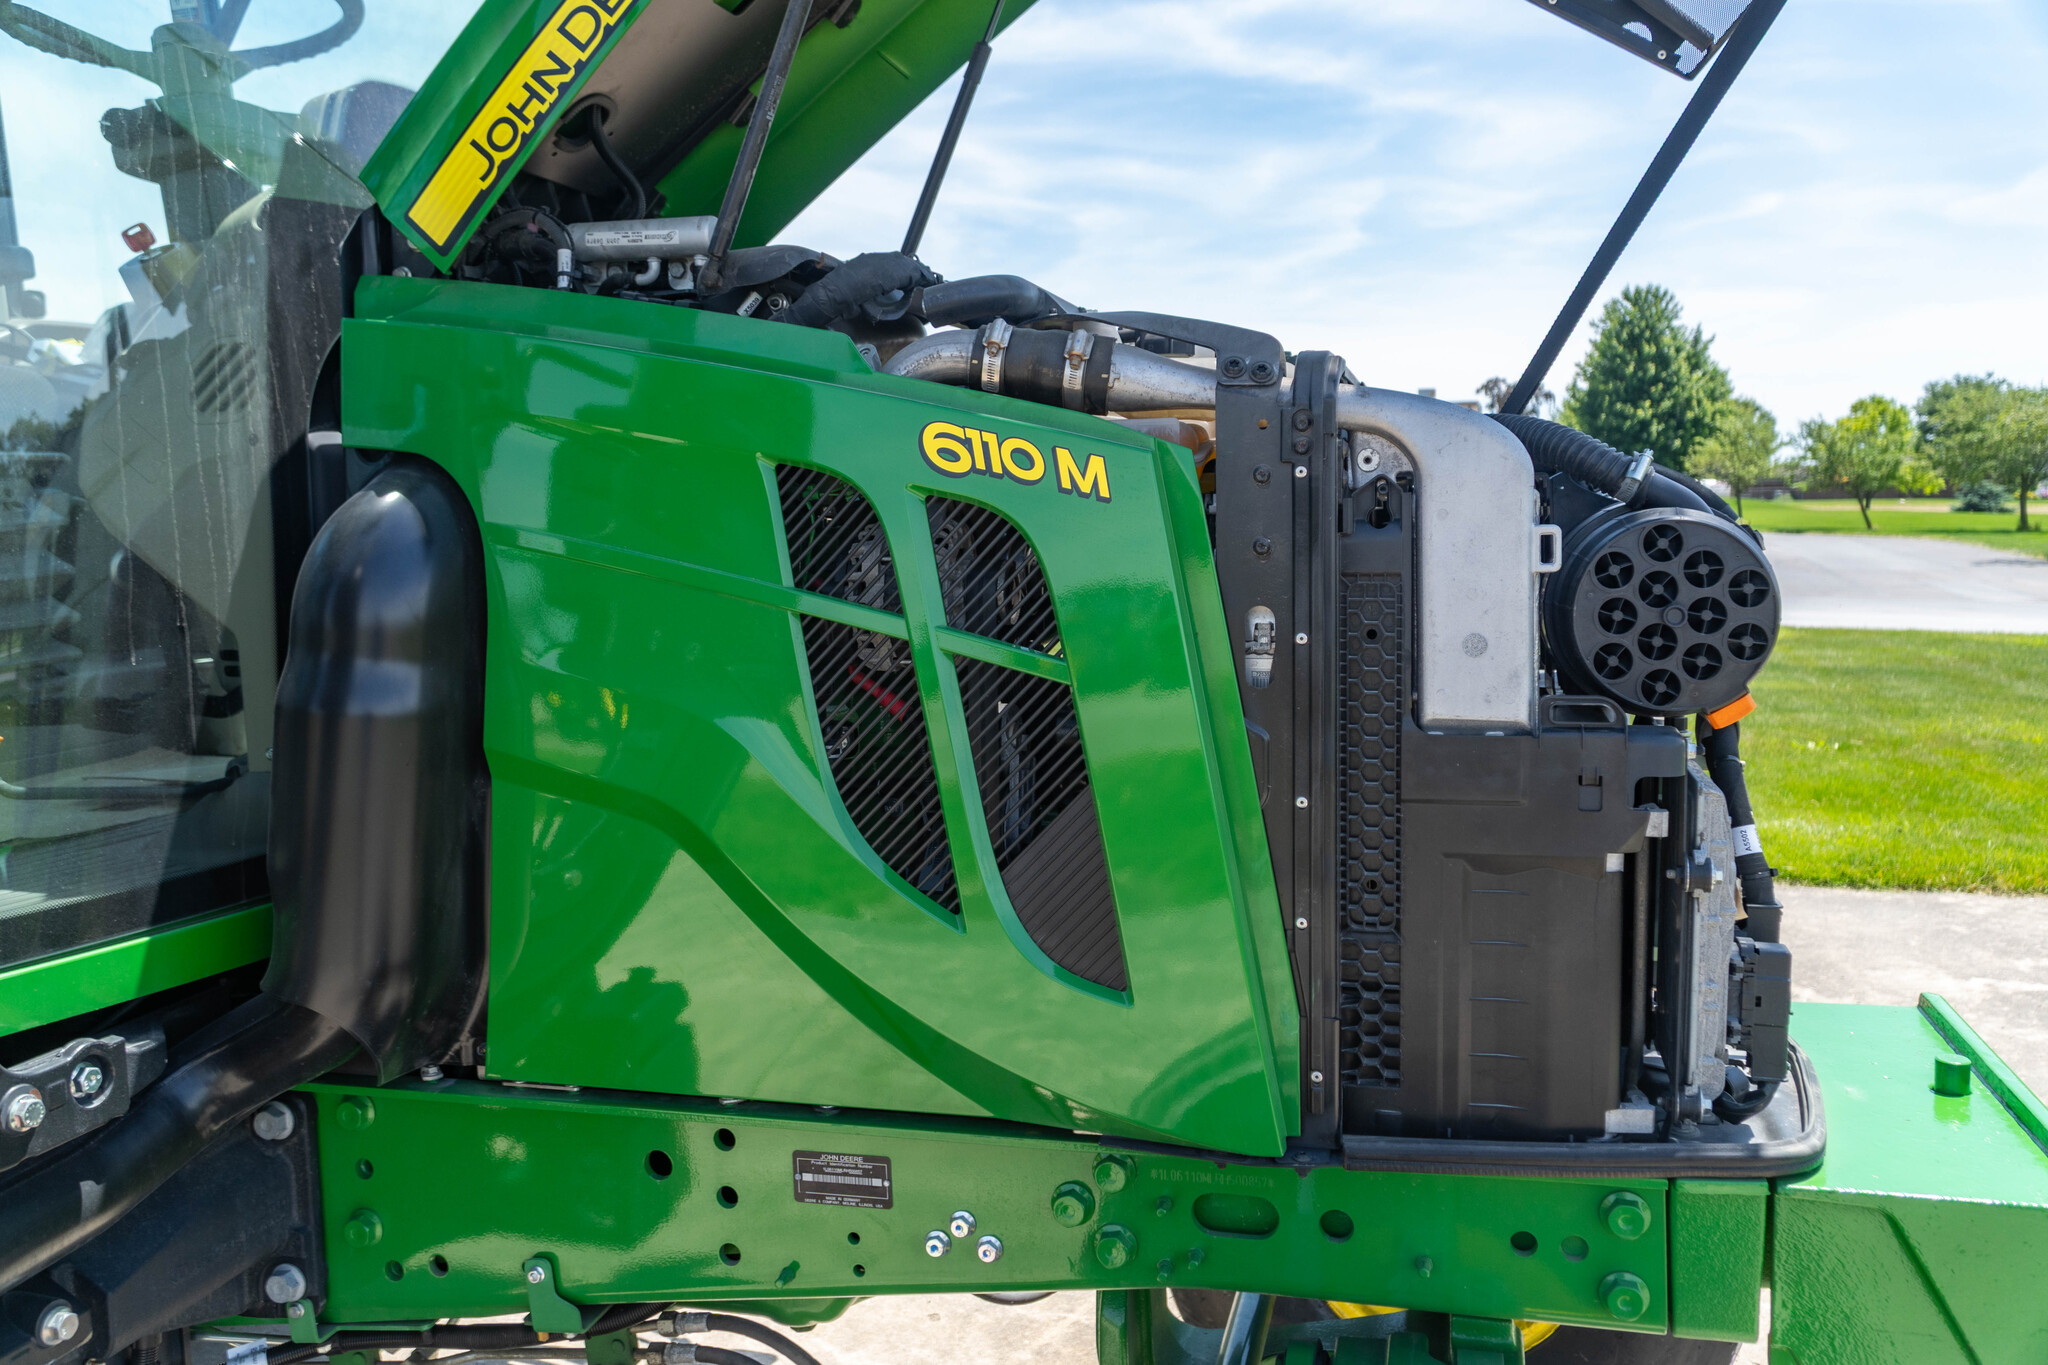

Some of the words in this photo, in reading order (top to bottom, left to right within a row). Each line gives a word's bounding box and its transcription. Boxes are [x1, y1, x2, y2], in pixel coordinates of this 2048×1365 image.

[470, 50, 575, 182] JOHN
[918, 420, 1046, 486] 6110
[1051, 445, 1112, 504] M
[1740, 830, 1752, 851] A5502
